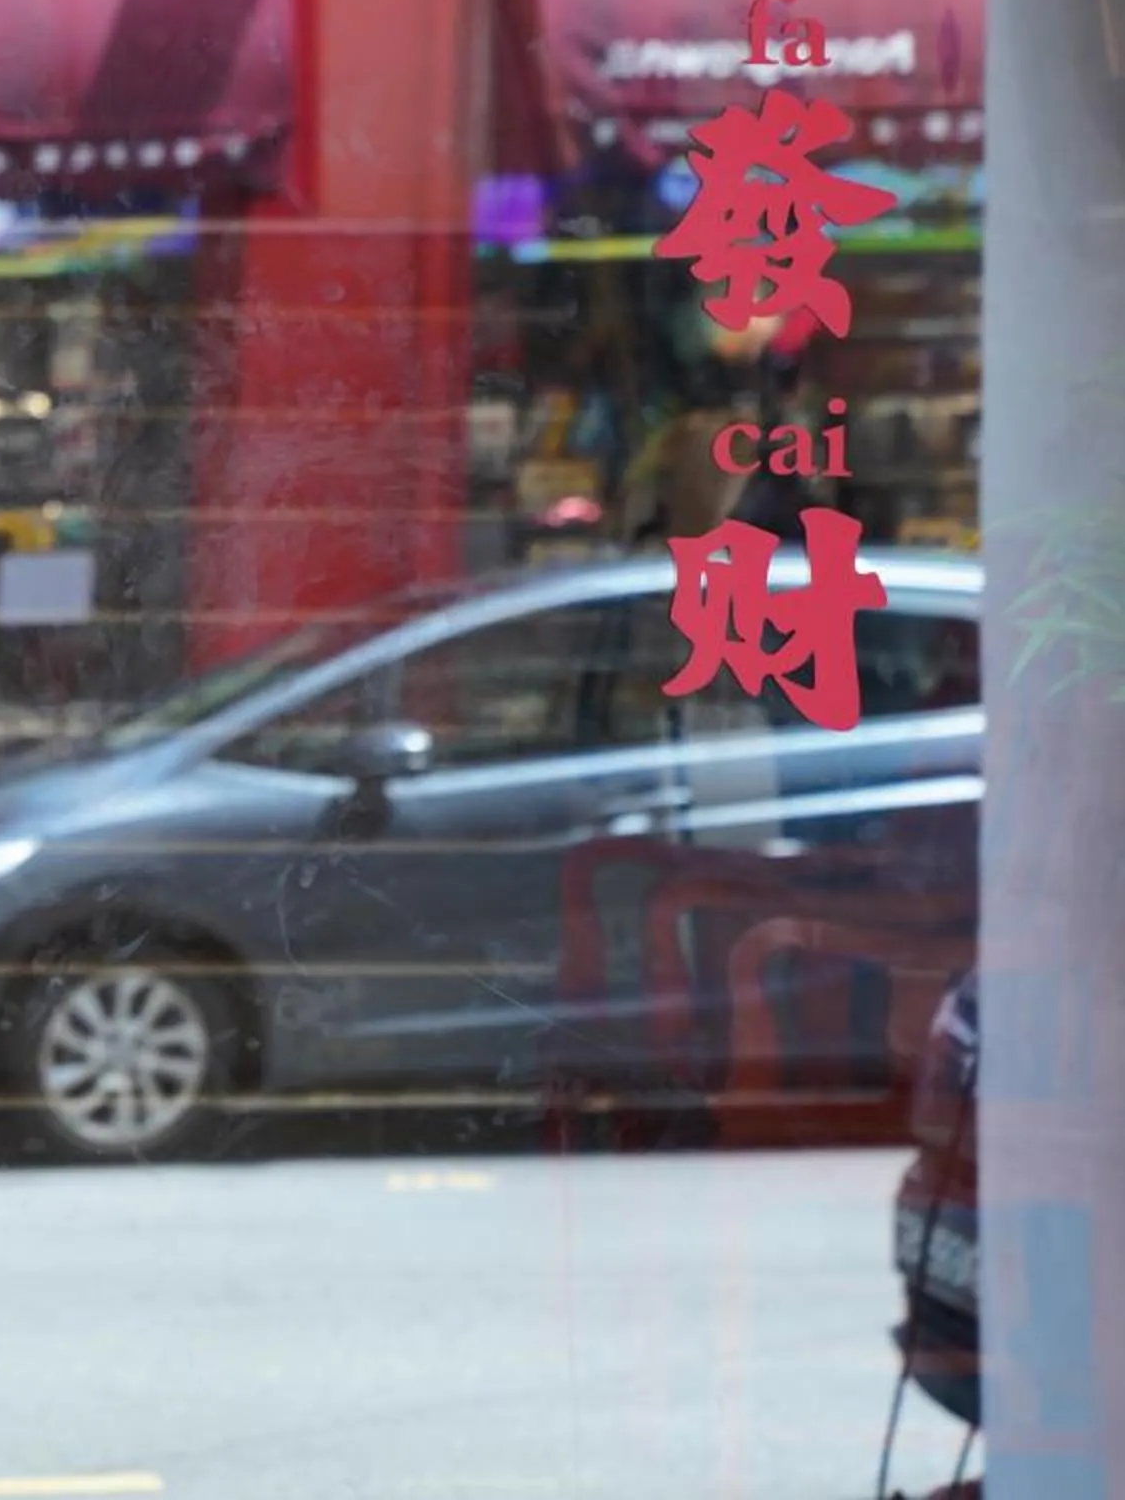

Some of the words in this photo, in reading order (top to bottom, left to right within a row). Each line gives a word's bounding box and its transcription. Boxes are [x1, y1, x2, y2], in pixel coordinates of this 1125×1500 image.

[652, 89, 899, 339] 發
[711, 397, 853, 479] cai
[660, 507, 888, 732] 财
